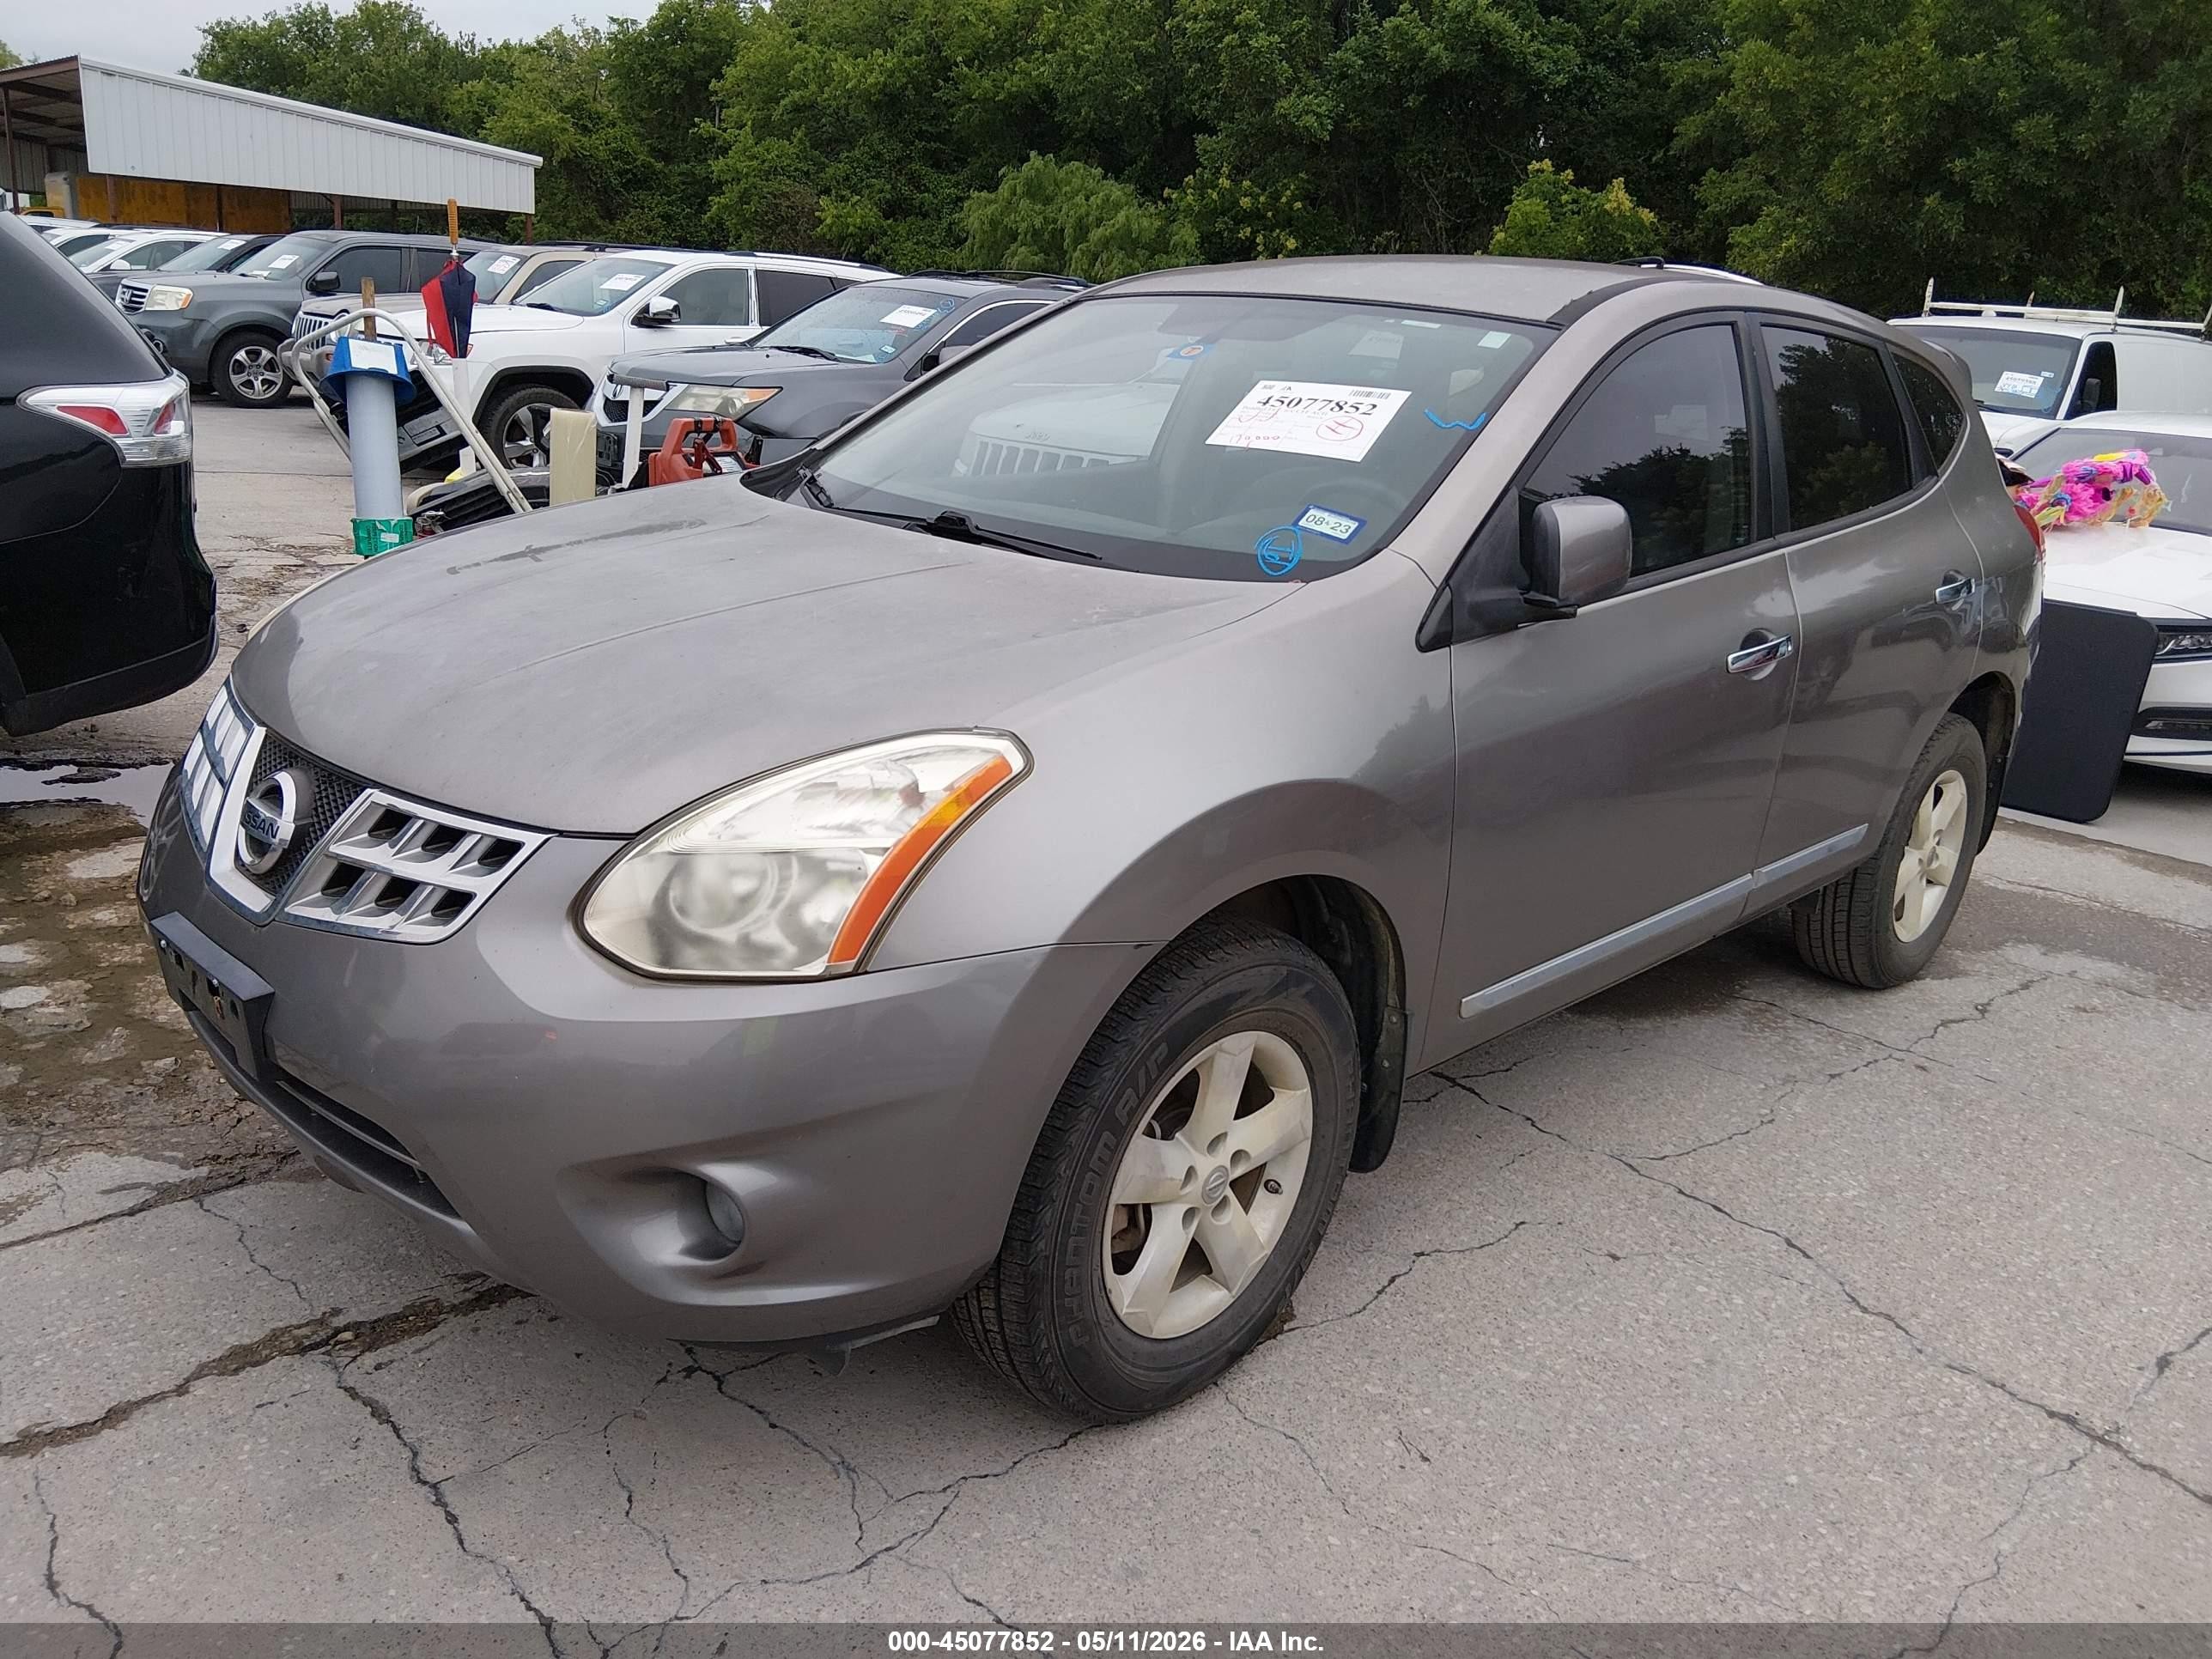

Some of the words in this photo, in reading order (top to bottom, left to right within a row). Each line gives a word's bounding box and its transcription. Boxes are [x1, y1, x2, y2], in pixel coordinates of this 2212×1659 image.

[1257, 395, 1377, 416] 45077852
[1305, 514, 1326, 526] 08
[1330, 521, 1352, 534] 23
[243, 810, 280, 839] SSAN
[1064, 1130, 1117, 1347] PHANTOM
